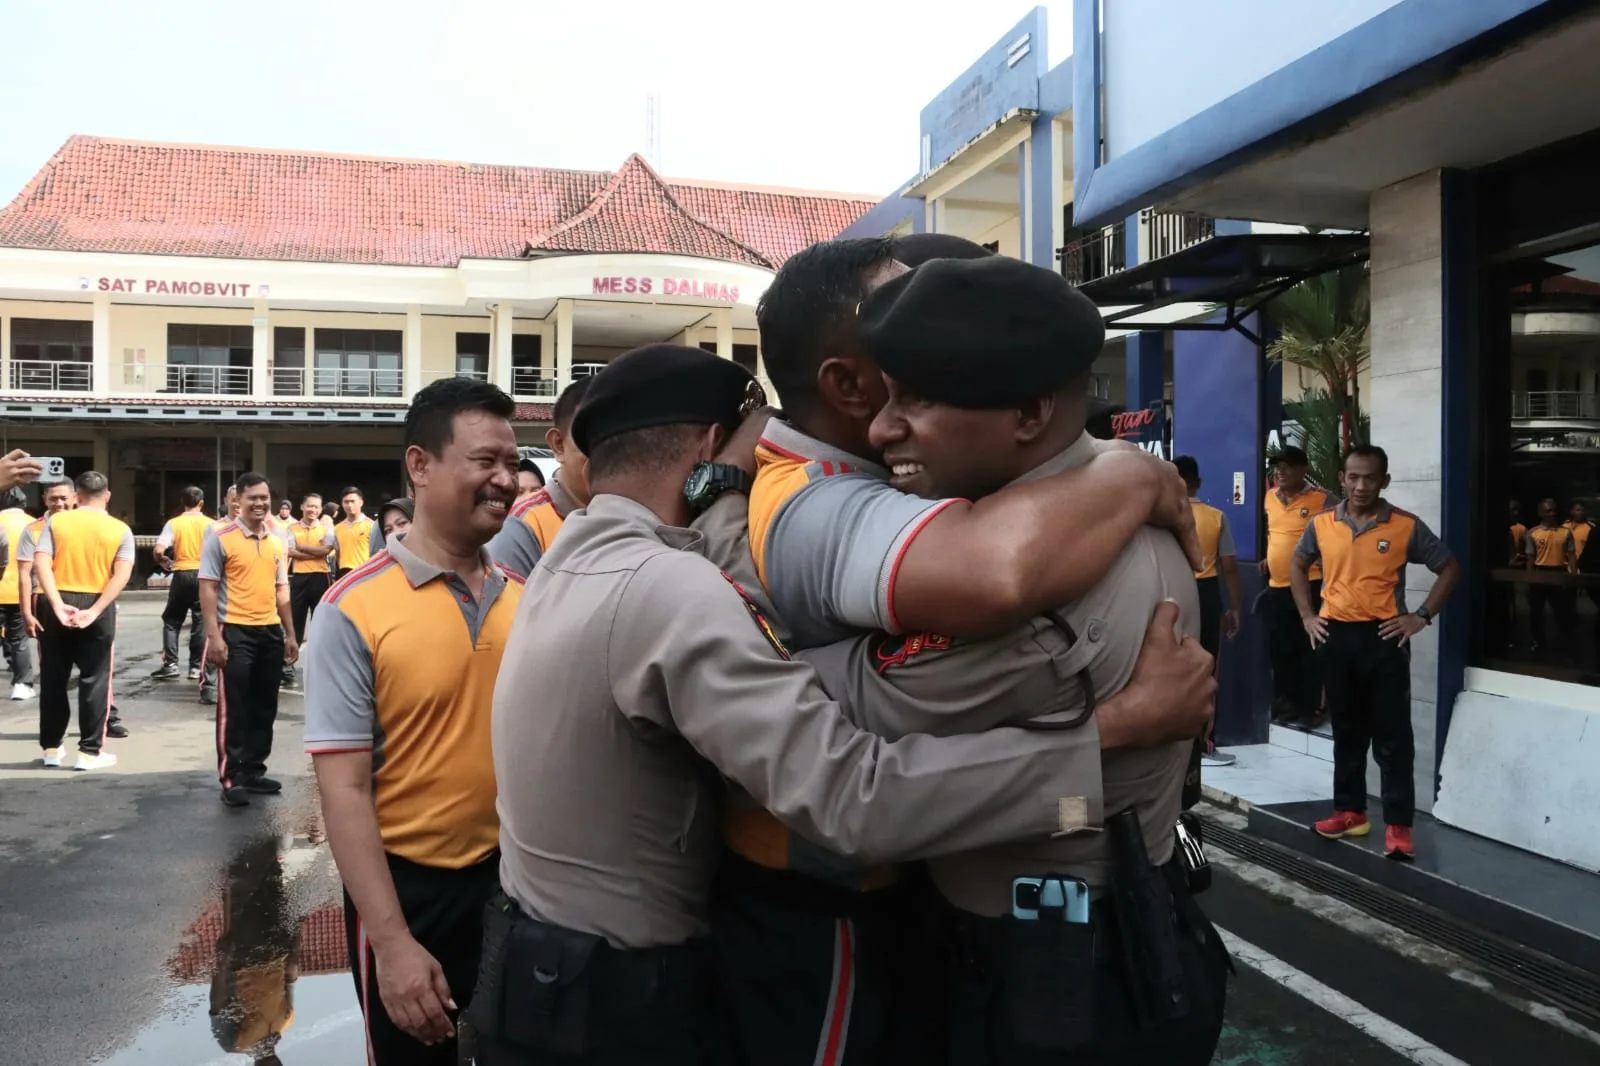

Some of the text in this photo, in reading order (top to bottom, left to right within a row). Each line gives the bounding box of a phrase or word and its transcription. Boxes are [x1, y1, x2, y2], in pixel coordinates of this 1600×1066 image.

[98, 277, 251, 297] SAT PAMOBVIT
[593, 277, 740, 303] MESS DALMAS
